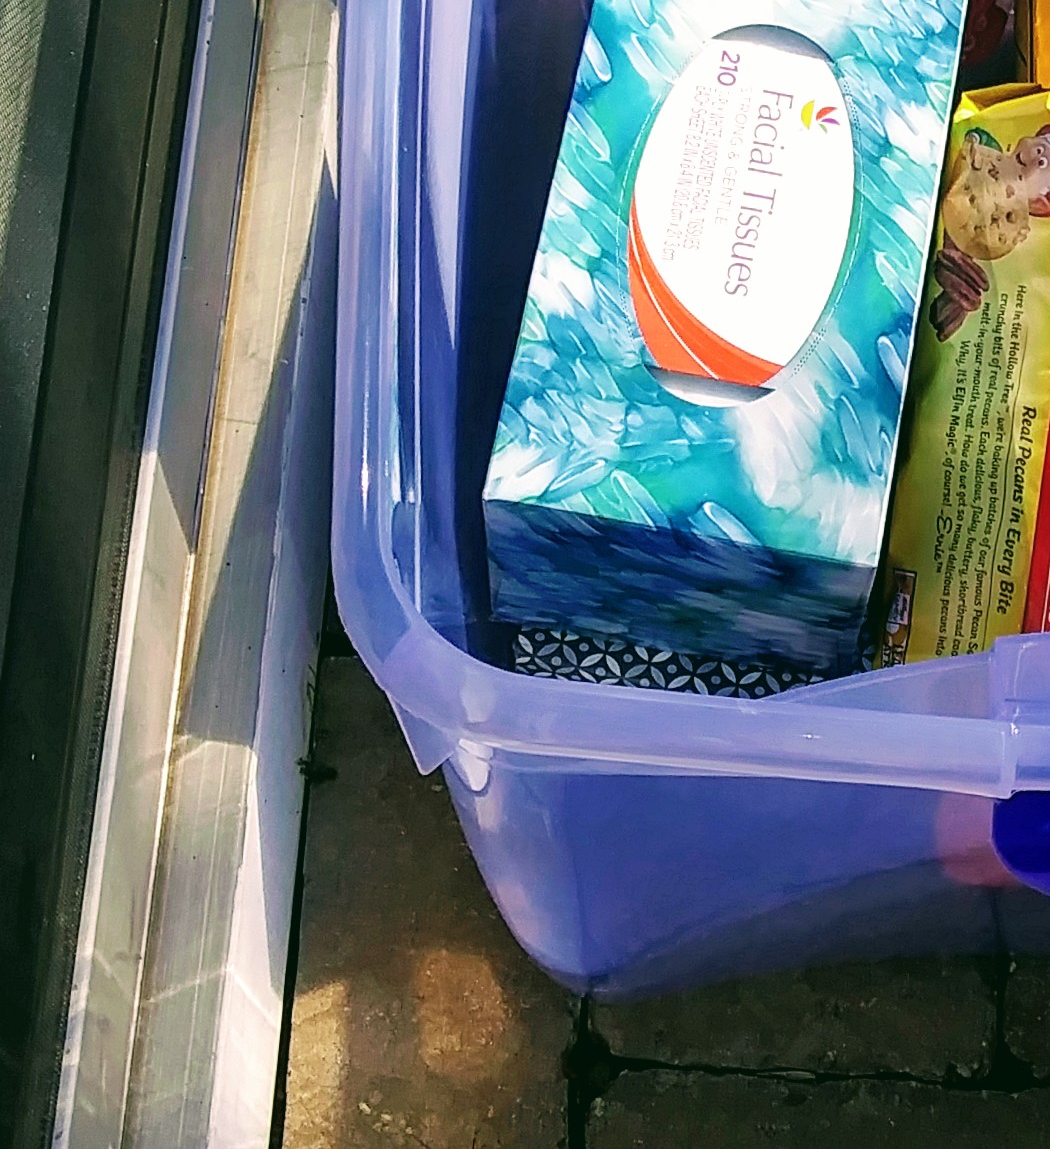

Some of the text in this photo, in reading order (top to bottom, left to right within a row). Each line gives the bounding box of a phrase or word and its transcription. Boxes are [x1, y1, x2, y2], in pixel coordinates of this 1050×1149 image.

[717, 50, 741, 87] 210
[715, 167, 737, 226] GENTLE
[724, 89, 794, 297] Facial Tissues
[992, 293, 1008, 335] crunchy
[1016, 284, 1027, 309] Here
[992, 334, 1003, 357] bits
[1011, 323, 1022, 339] the
[988, 357, 1001, 370] of
[1007, 341, 1020, 381] Hollow
[965, 403, 978, 429] treat.
[980, 390, 992, 430] pecans.
[963, 431, 974, 460] How
[978, 430, 990, 456] Each
[973, 457, 986, 503] delicious,
[988, 444, 1001, 480] baking
[990, 482, 998, 495] up
[967, 505, 983, 537] flaky,
[984, 495, 999, 535] batches
[997, 405, 1037, 615] Real Pecans in Every Bite
[961, 536, 976, 578] buttery,
[976, 550, 987, 566] our
[979, 536, 991, 550] of
[974, 567, 986, 606] famous
[956, 579, 969, 642] shortbread
[970, 607, 983, 640] Pecan
